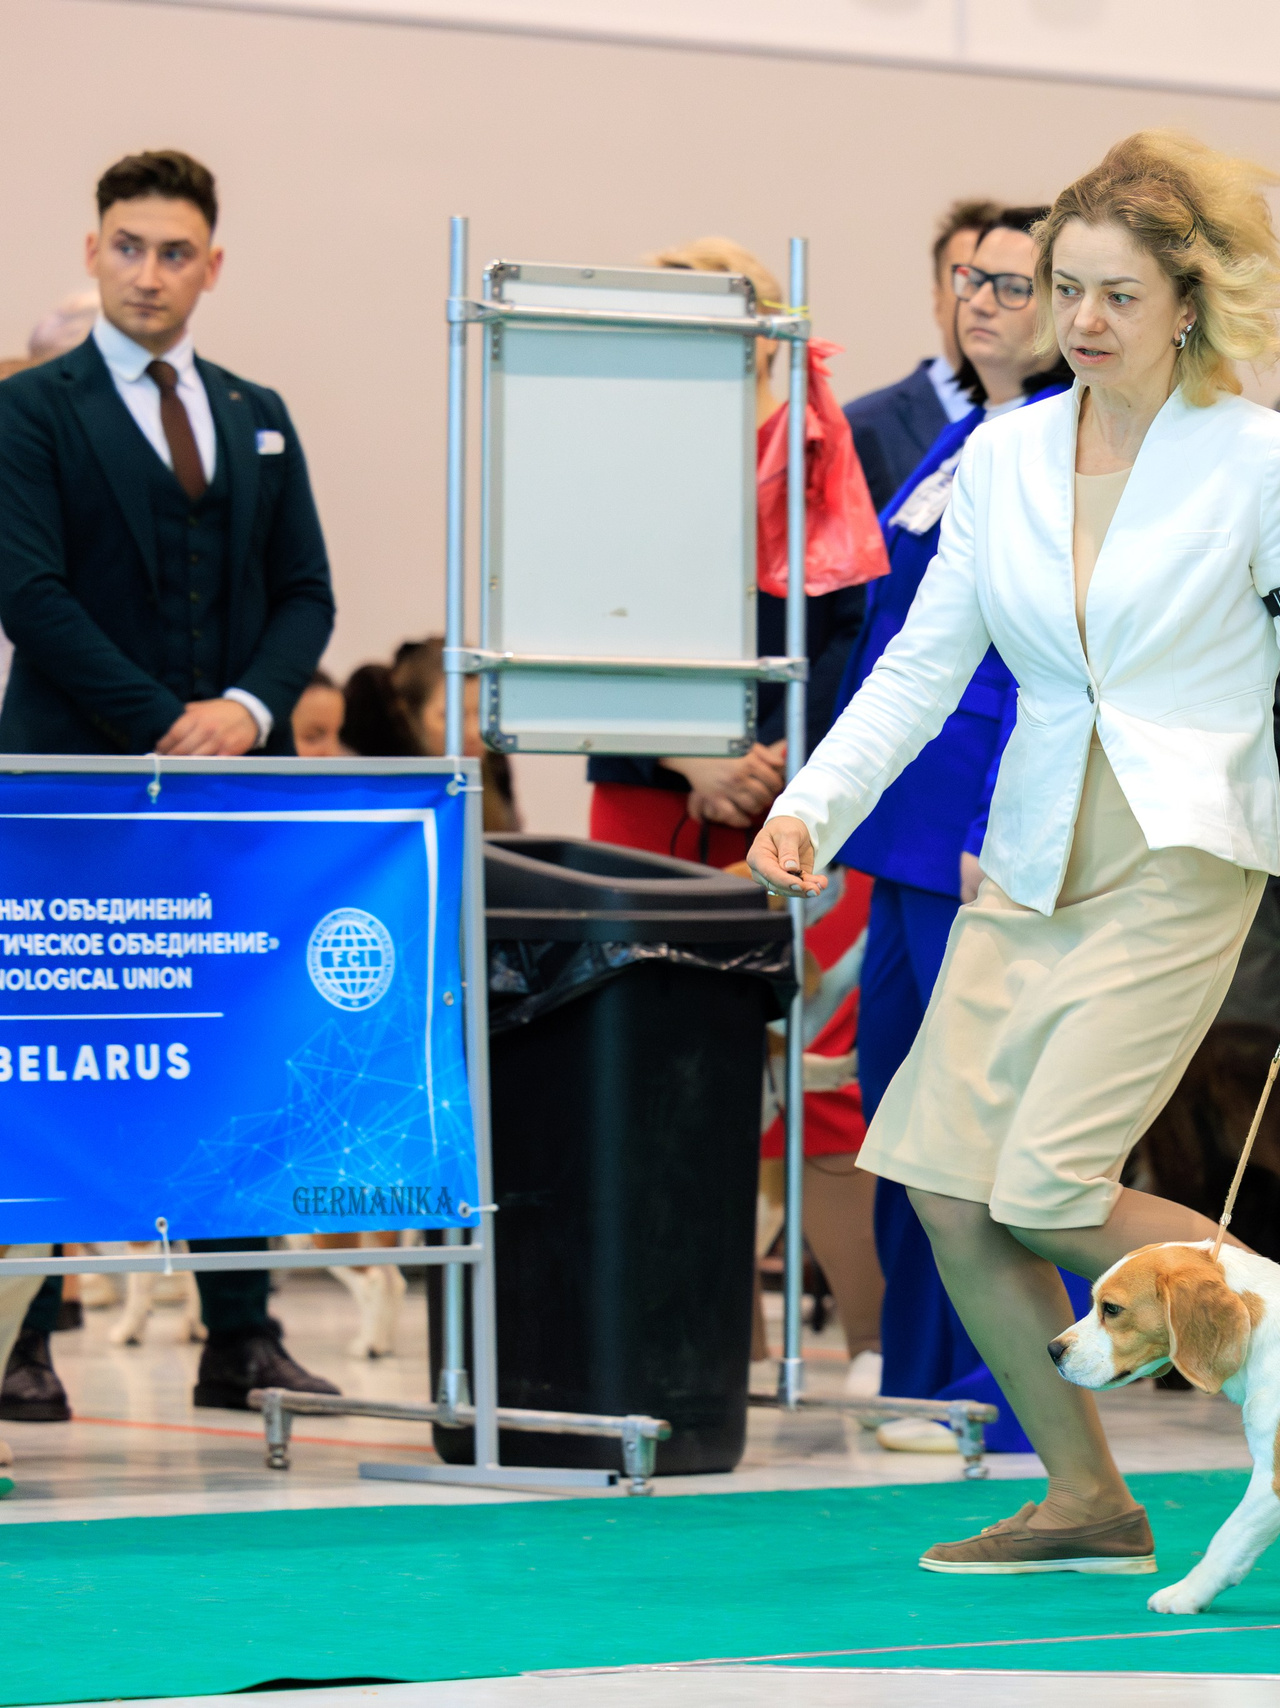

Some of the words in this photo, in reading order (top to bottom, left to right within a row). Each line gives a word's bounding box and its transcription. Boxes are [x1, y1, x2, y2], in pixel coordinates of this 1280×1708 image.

[49, 893, 212, 924] ОБЪЕДИНЕНИЙ
[108, 931, 280, 957] ОБЪЕДИНЕНИЕ»
[332, 951, 370, 967] FCI
[123, 967, 192, 989] UNION
